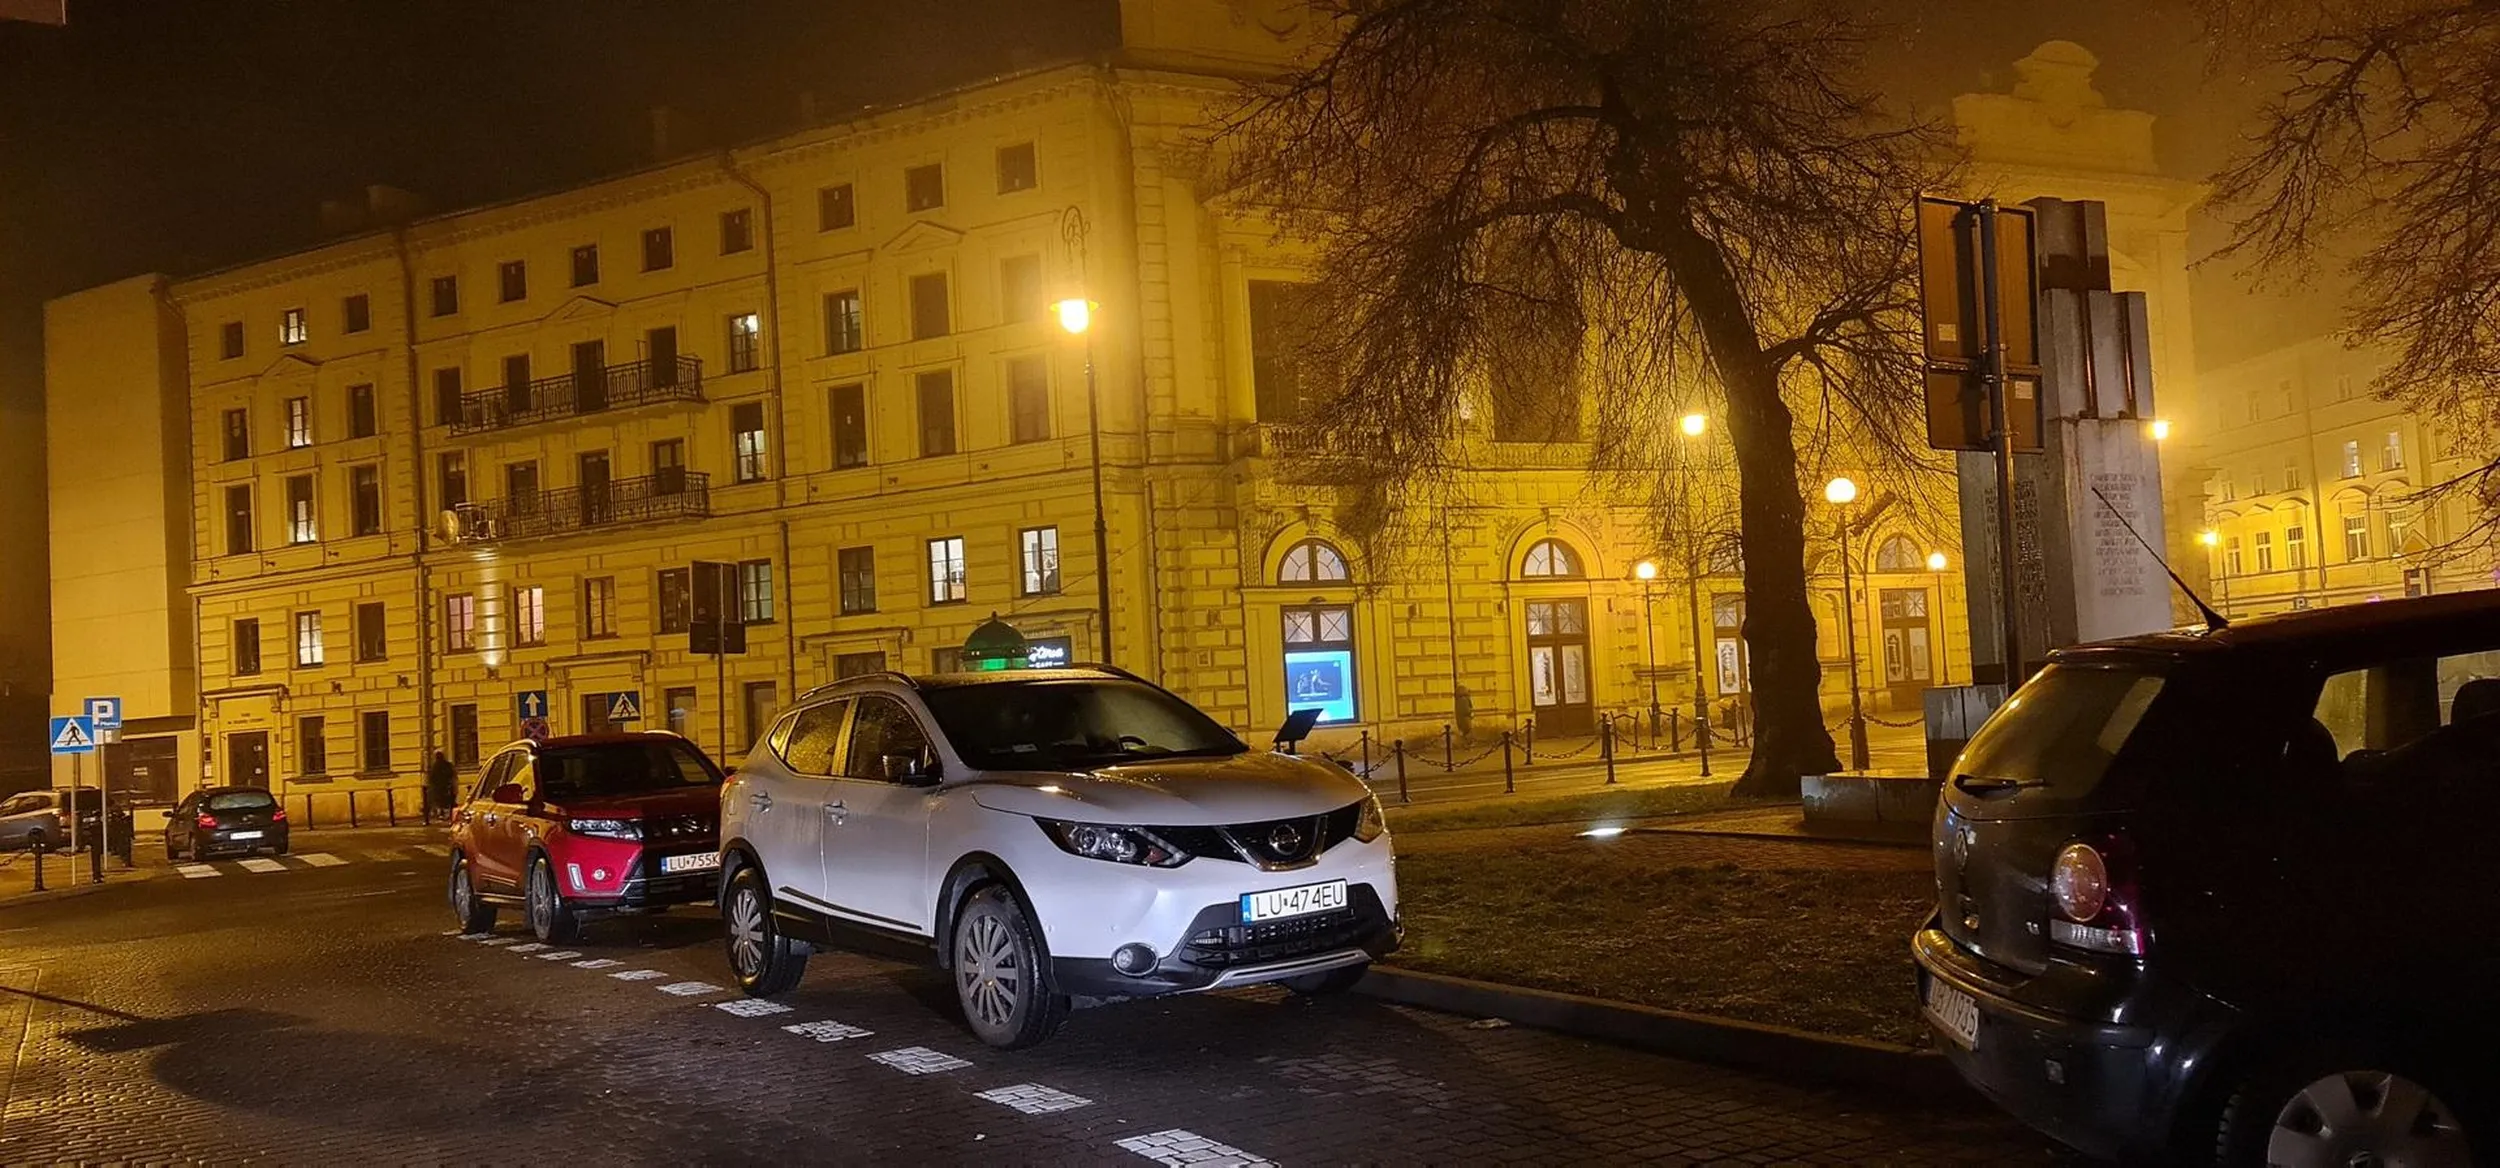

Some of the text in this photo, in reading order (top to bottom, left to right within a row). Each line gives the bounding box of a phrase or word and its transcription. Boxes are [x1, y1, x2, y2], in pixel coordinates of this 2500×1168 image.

[92, 701, 113, 725] P
[669, 857, 686, 870] LU
[1255, 883, 1344, 918] LU 474EU
